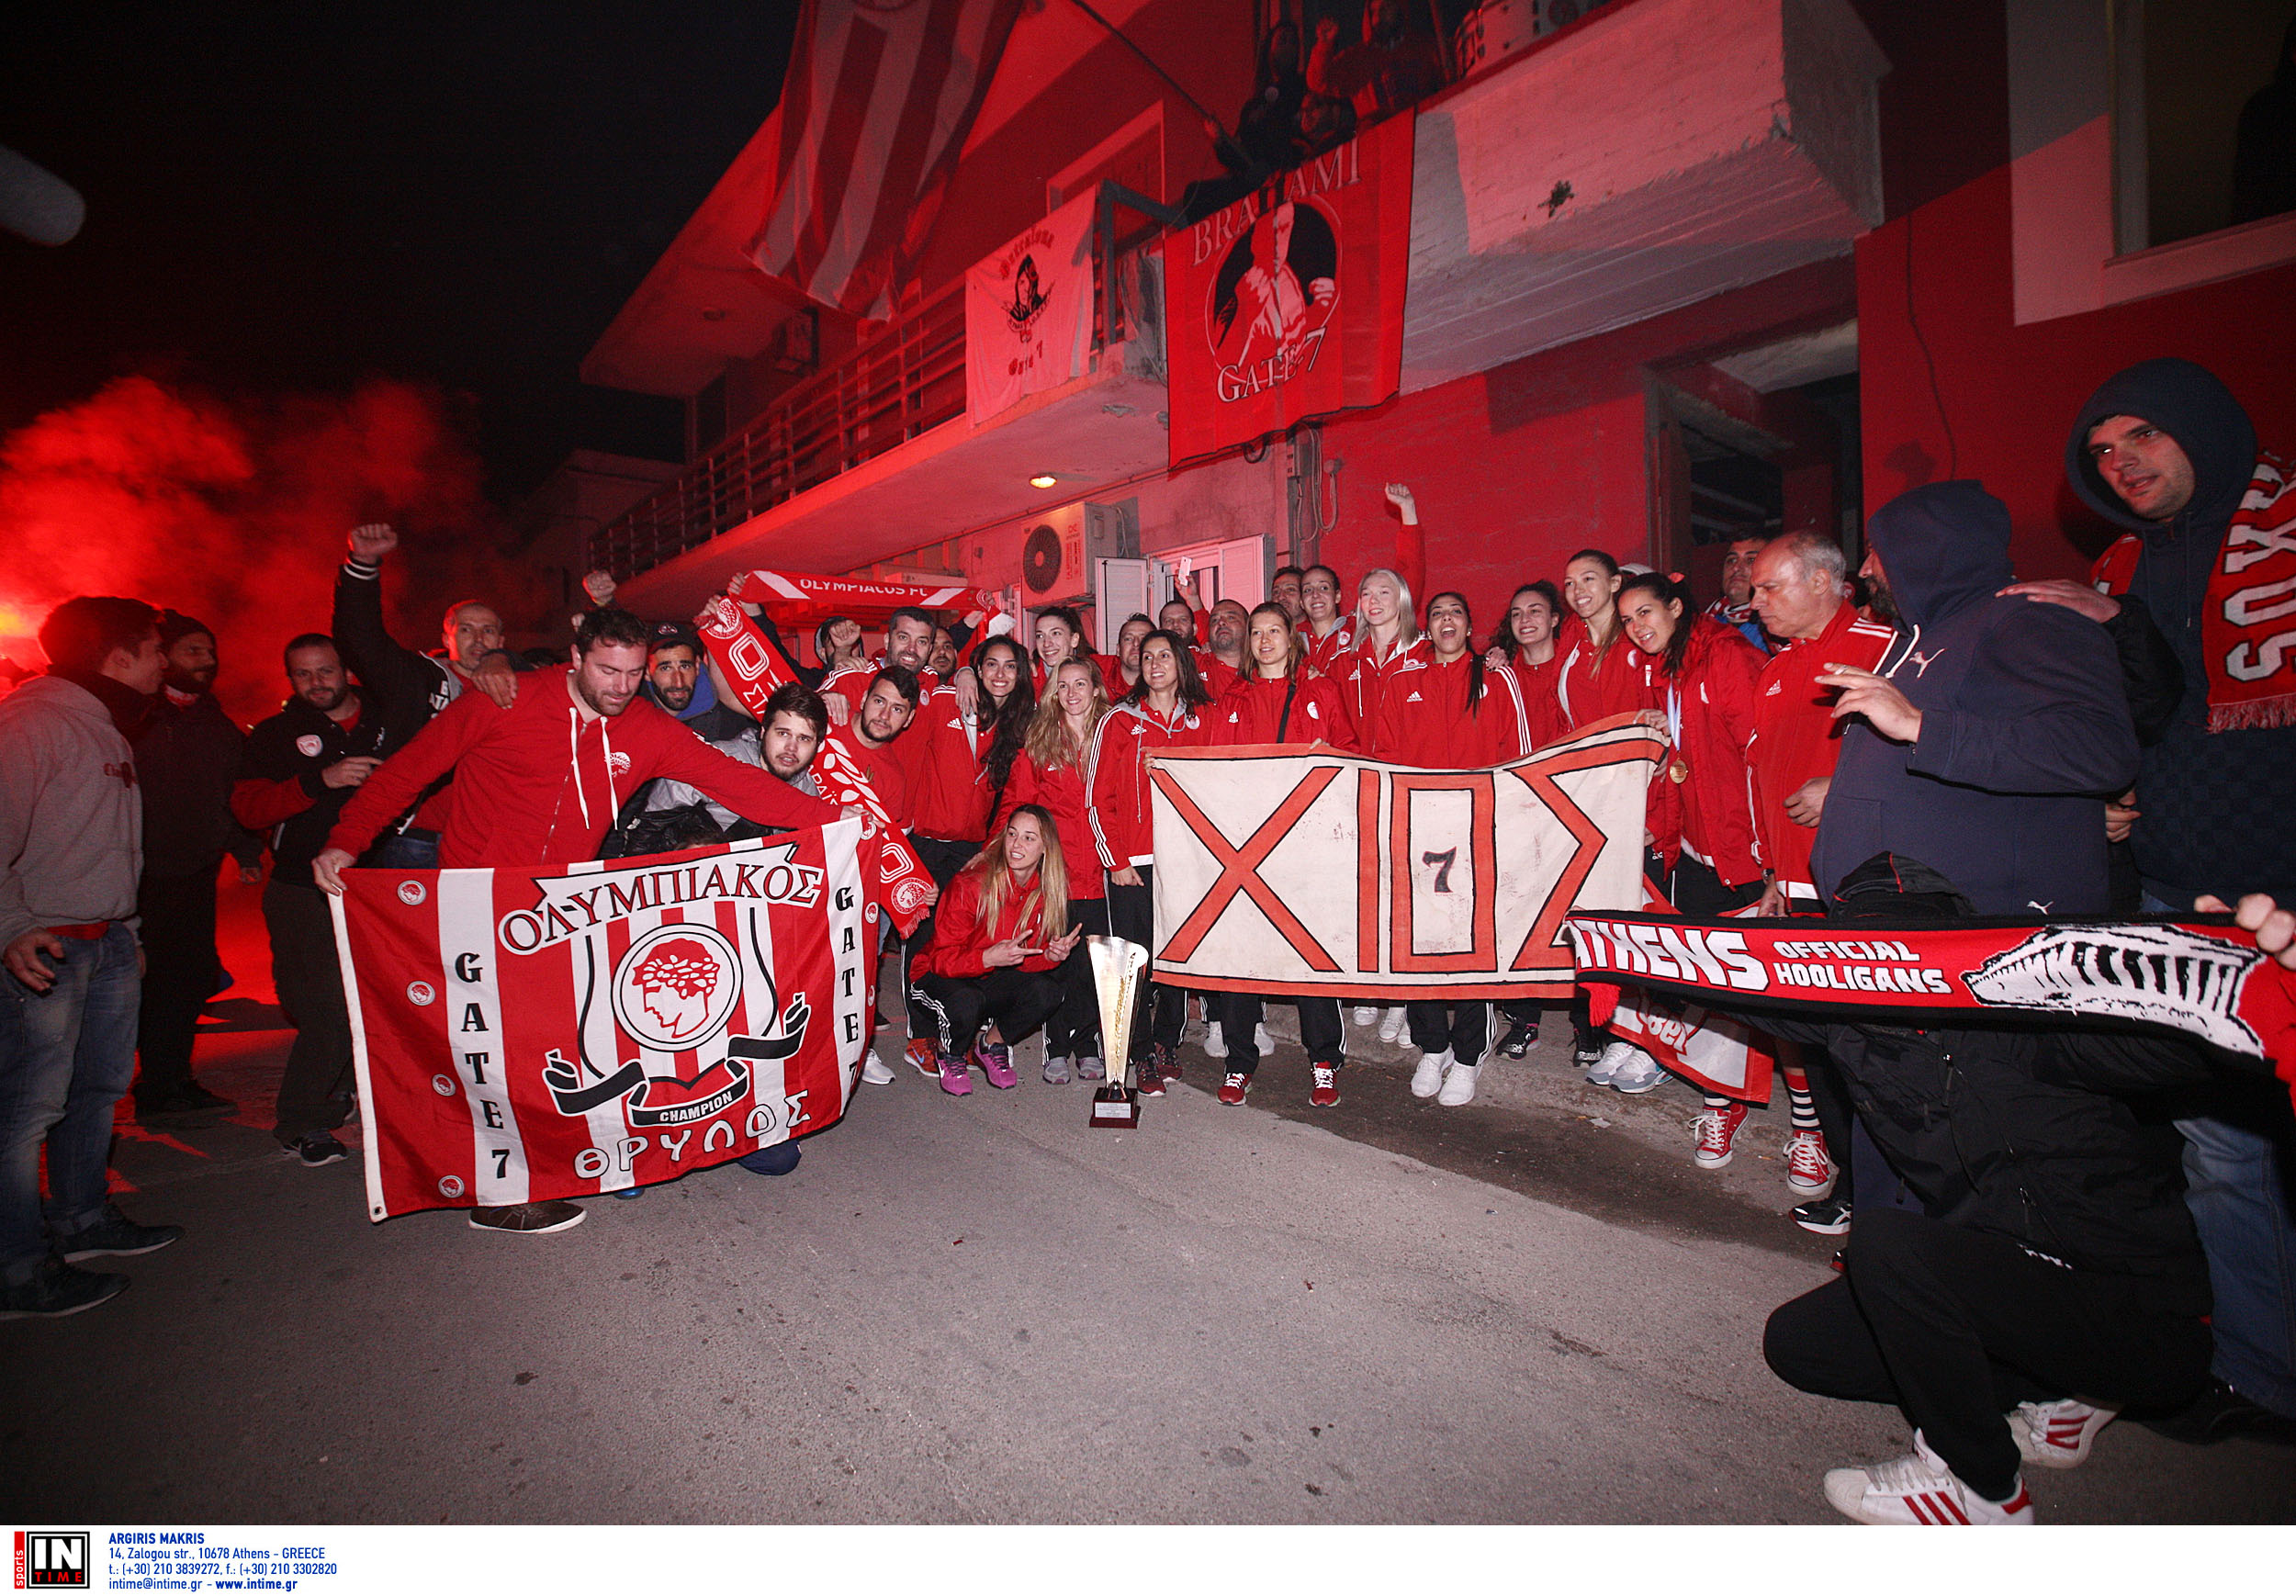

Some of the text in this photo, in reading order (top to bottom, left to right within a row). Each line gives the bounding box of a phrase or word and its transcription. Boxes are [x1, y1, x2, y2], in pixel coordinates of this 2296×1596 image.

[1193, 138, 1362, 267] BRAAMI
[1217, 326, 1327, 402] GATE 7
[1422, 846, 1458, 894] 7
[835, 886, 860, 1045] GATE
[1566, 919, 1771, 992] ATHENS
[1773, 940, 1920, 961] OFFICIAL
[1773, 962, 1953, 994] HOOLIGANS
[455, 952, 511, 1180] GATE 7
[574, 1089, 812, 1179] ΘΡΥΛΟΣ
[659, 1091, 733, 1122] CHAMPION
